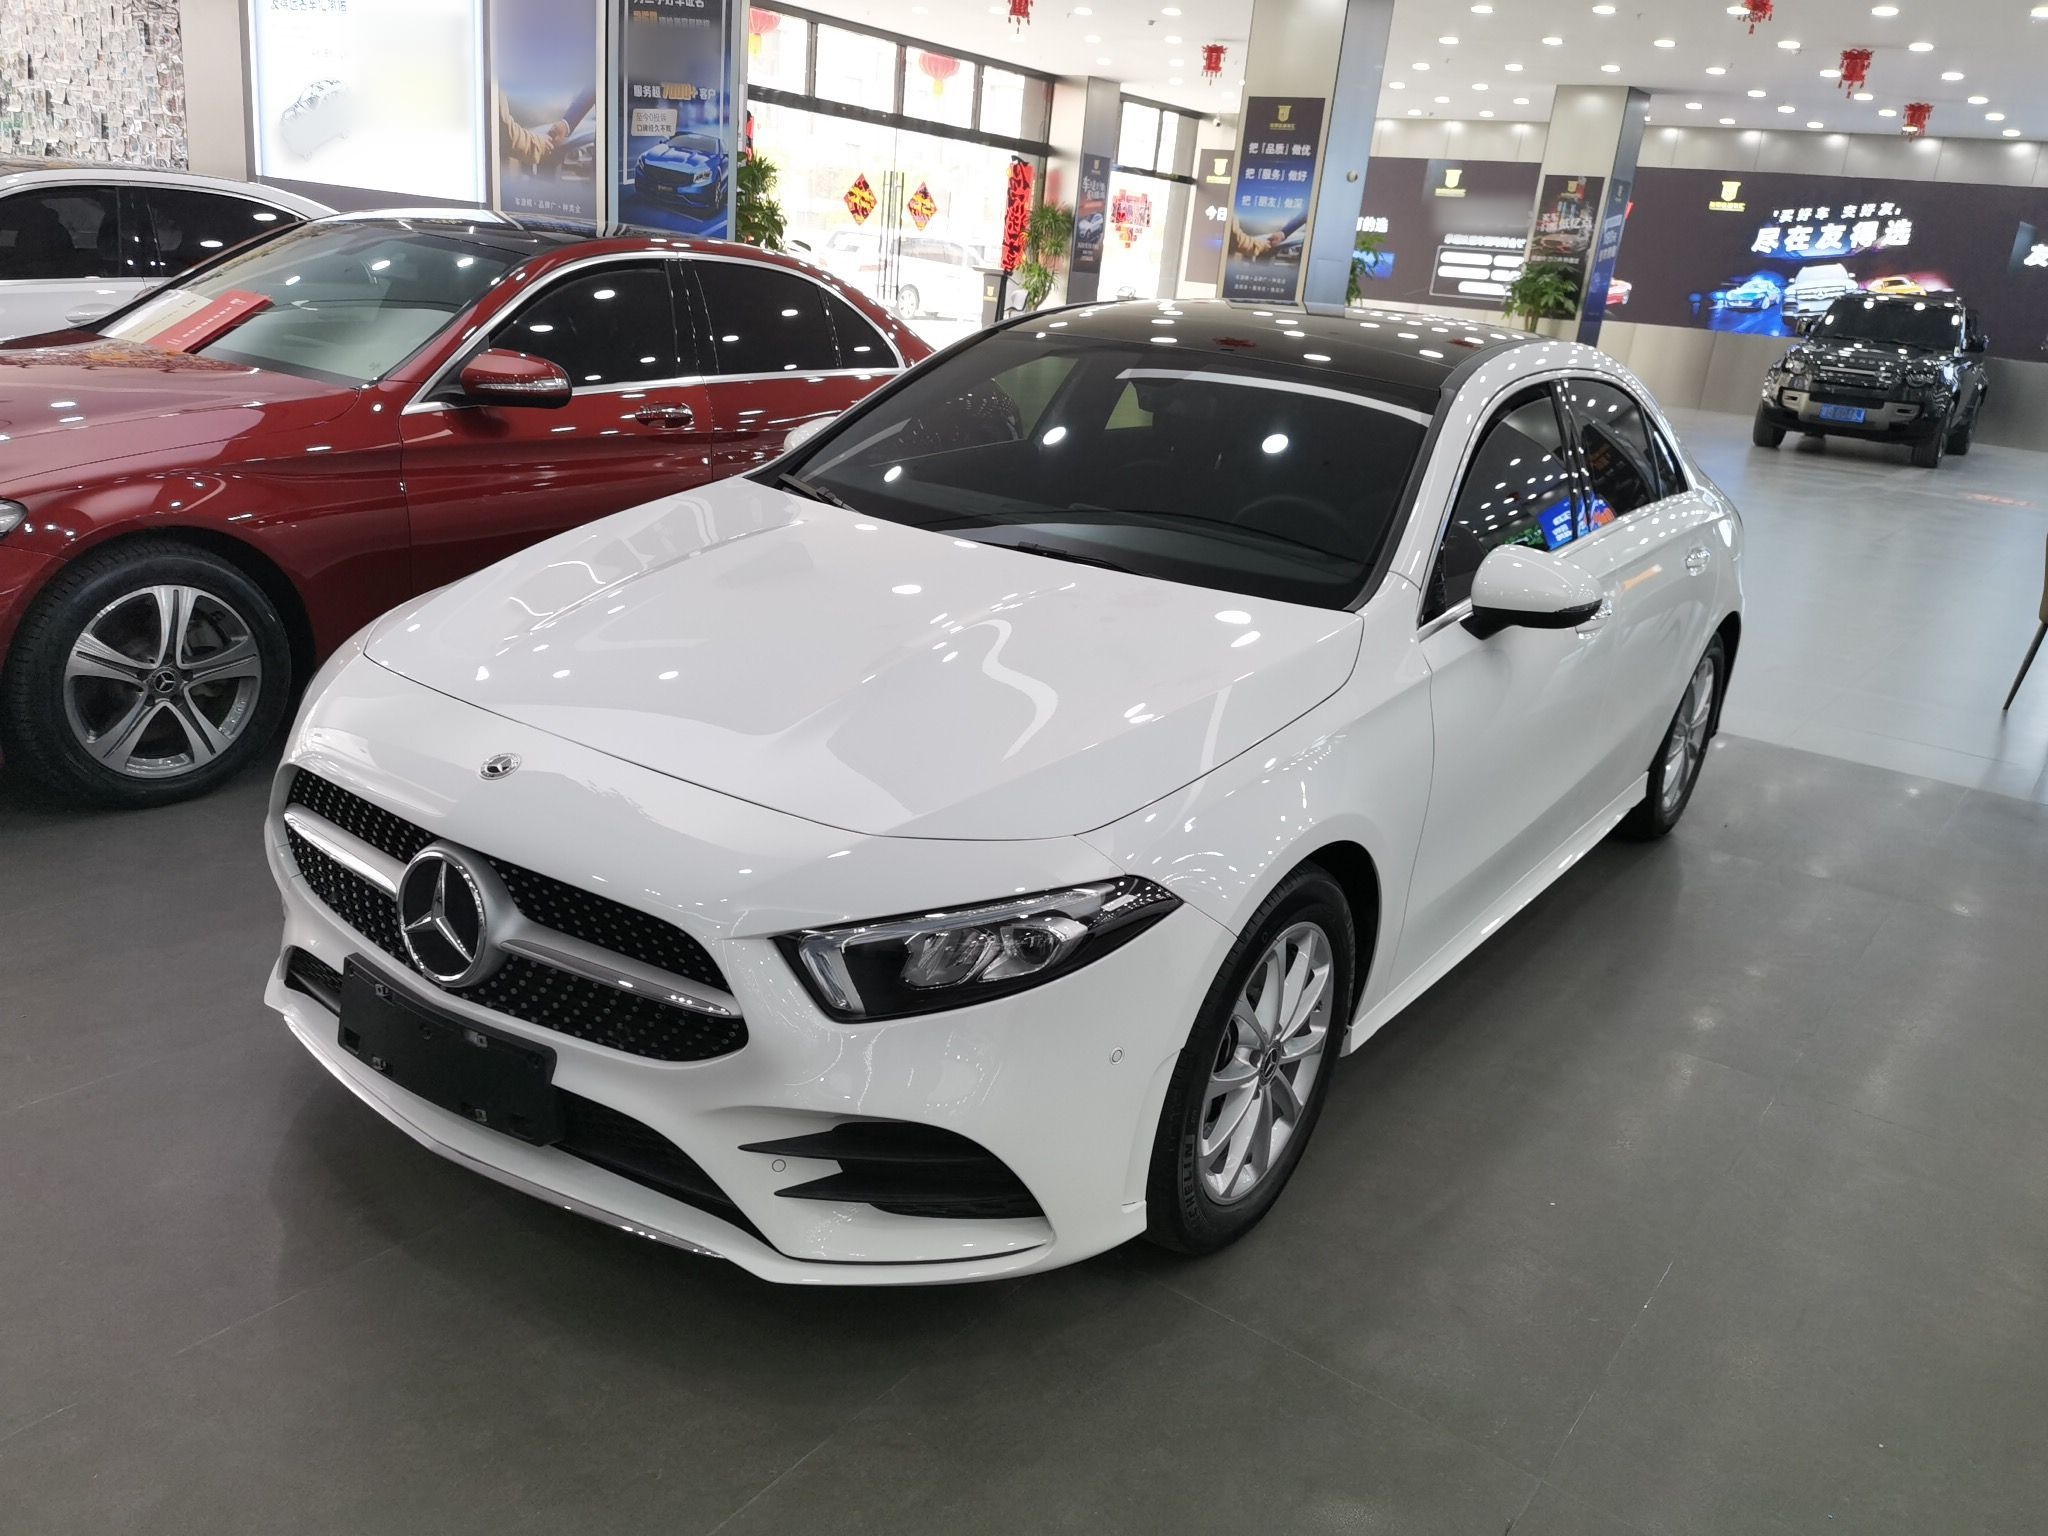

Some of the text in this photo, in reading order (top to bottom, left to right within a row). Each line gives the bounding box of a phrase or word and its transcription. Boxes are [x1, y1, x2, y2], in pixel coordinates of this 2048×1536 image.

[1750, 218, 1913, 254] 尽在友得选
